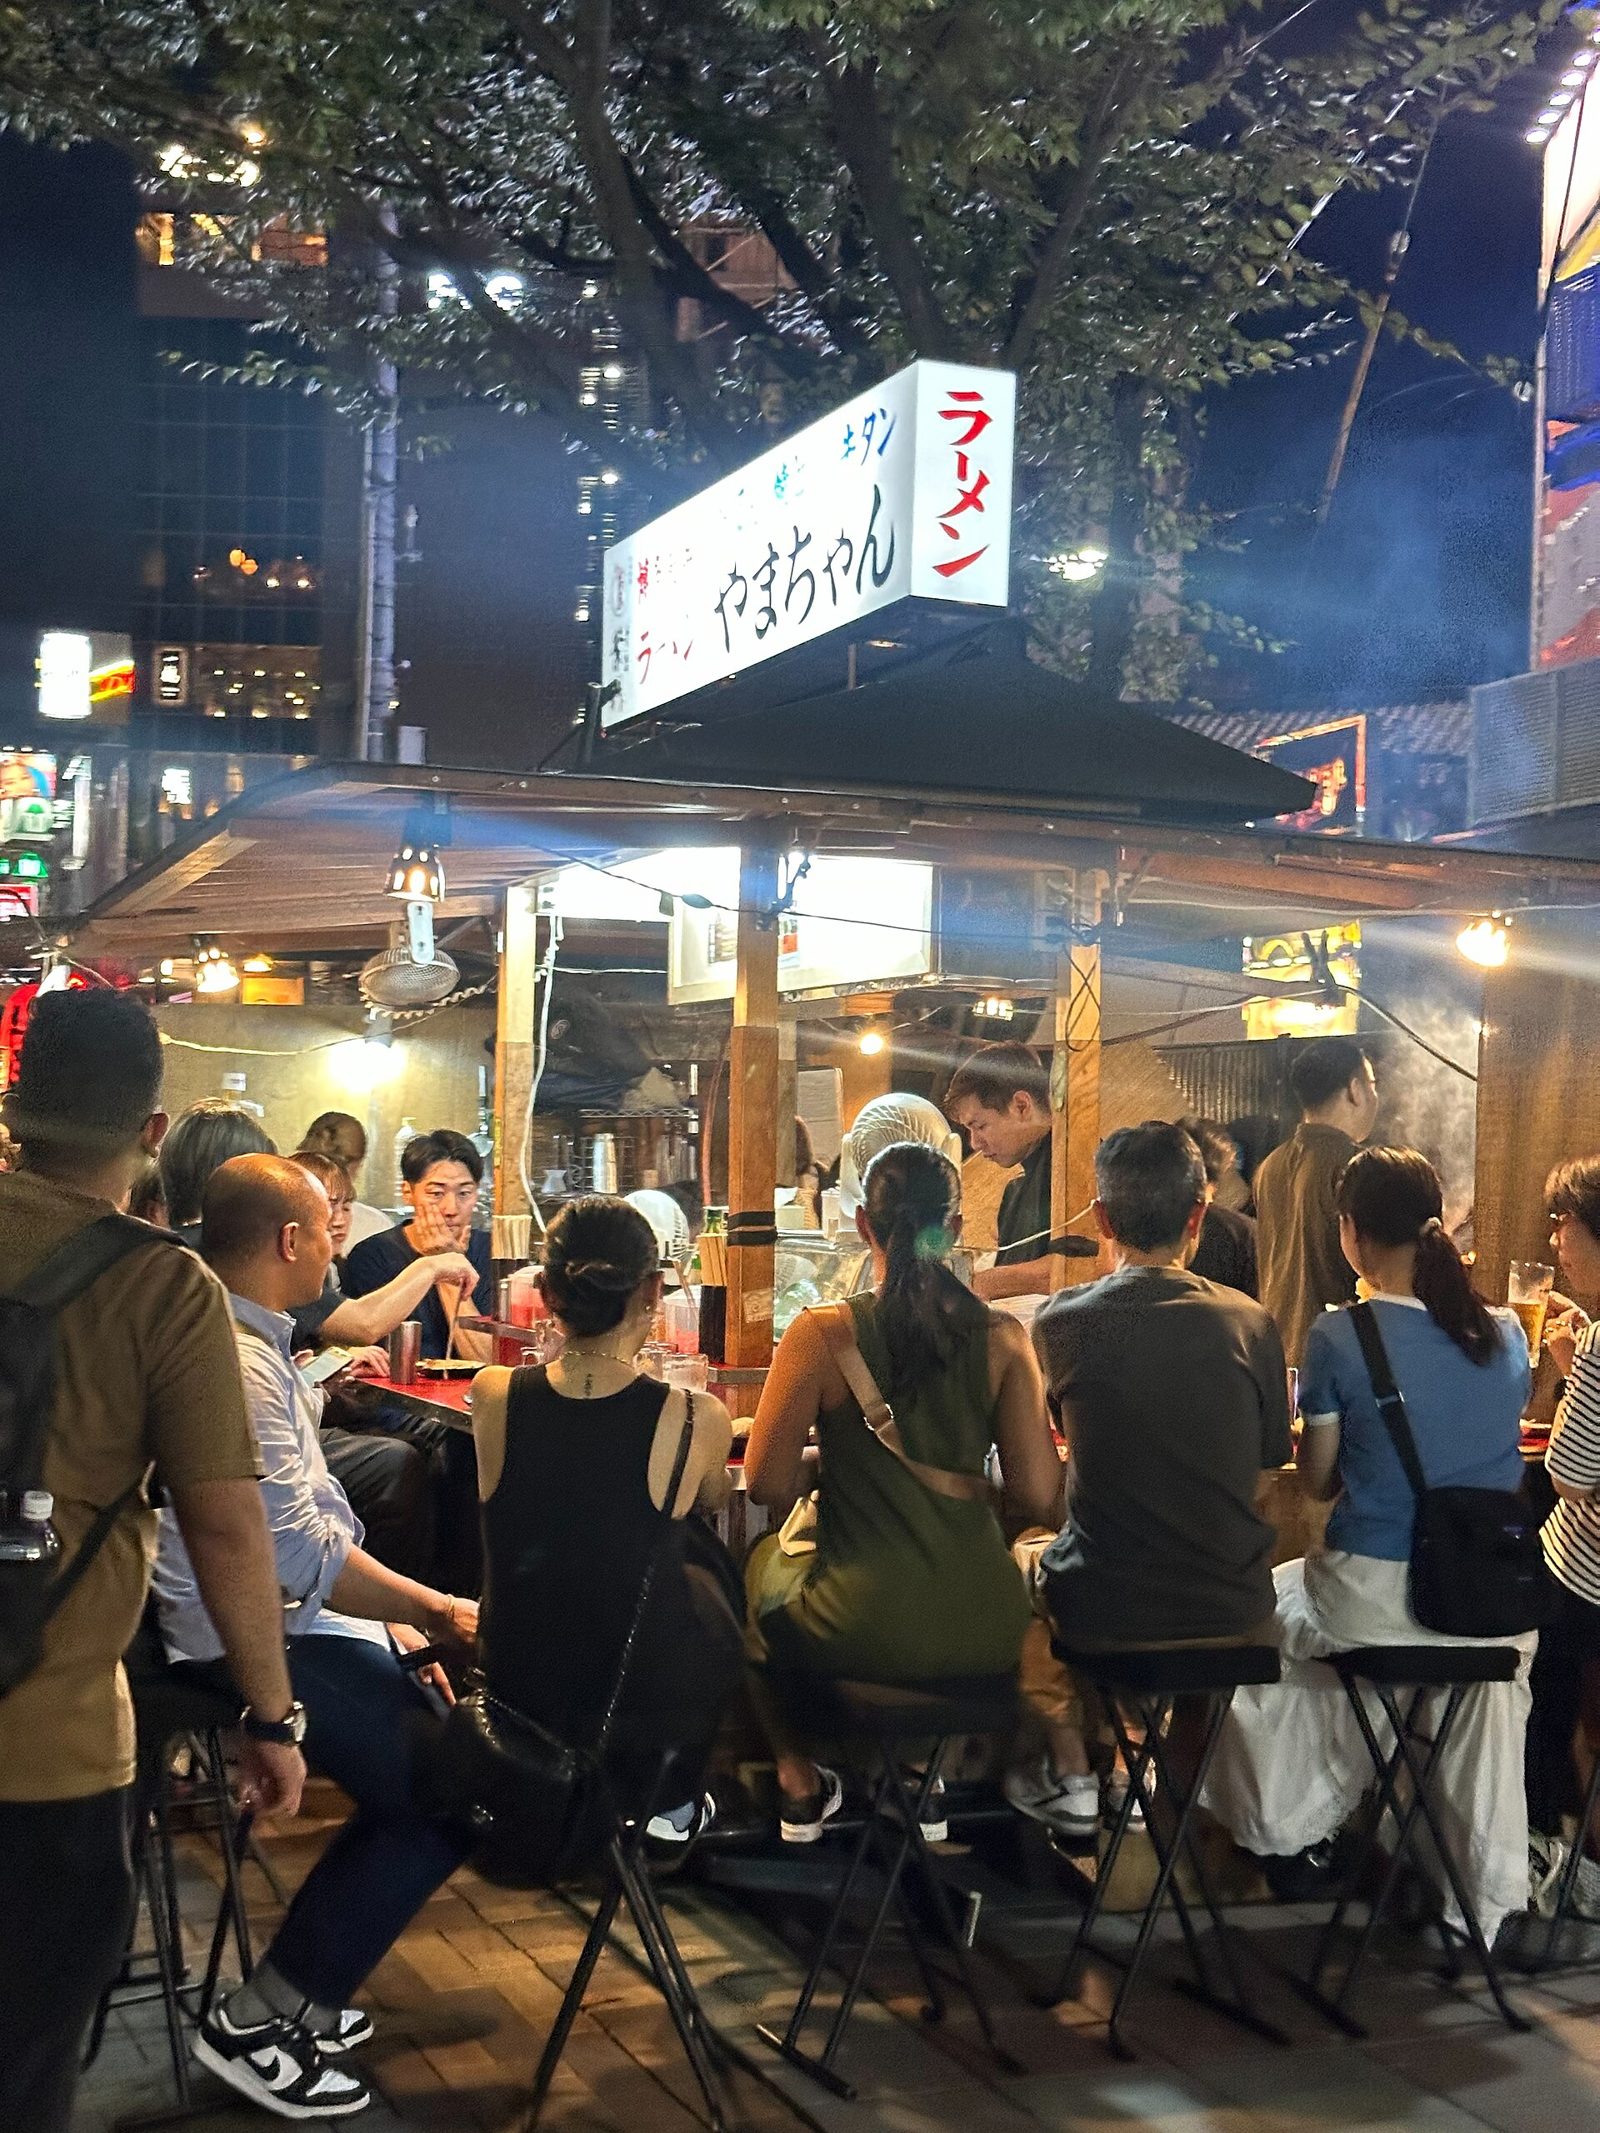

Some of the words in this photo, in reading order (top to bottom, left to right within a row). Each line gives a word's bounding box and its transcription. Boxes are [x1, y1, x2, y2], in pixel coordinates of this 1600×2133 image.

[714, 483, 895, 653] やまちゃん
[931, 390, 994, 578] ラーメン
